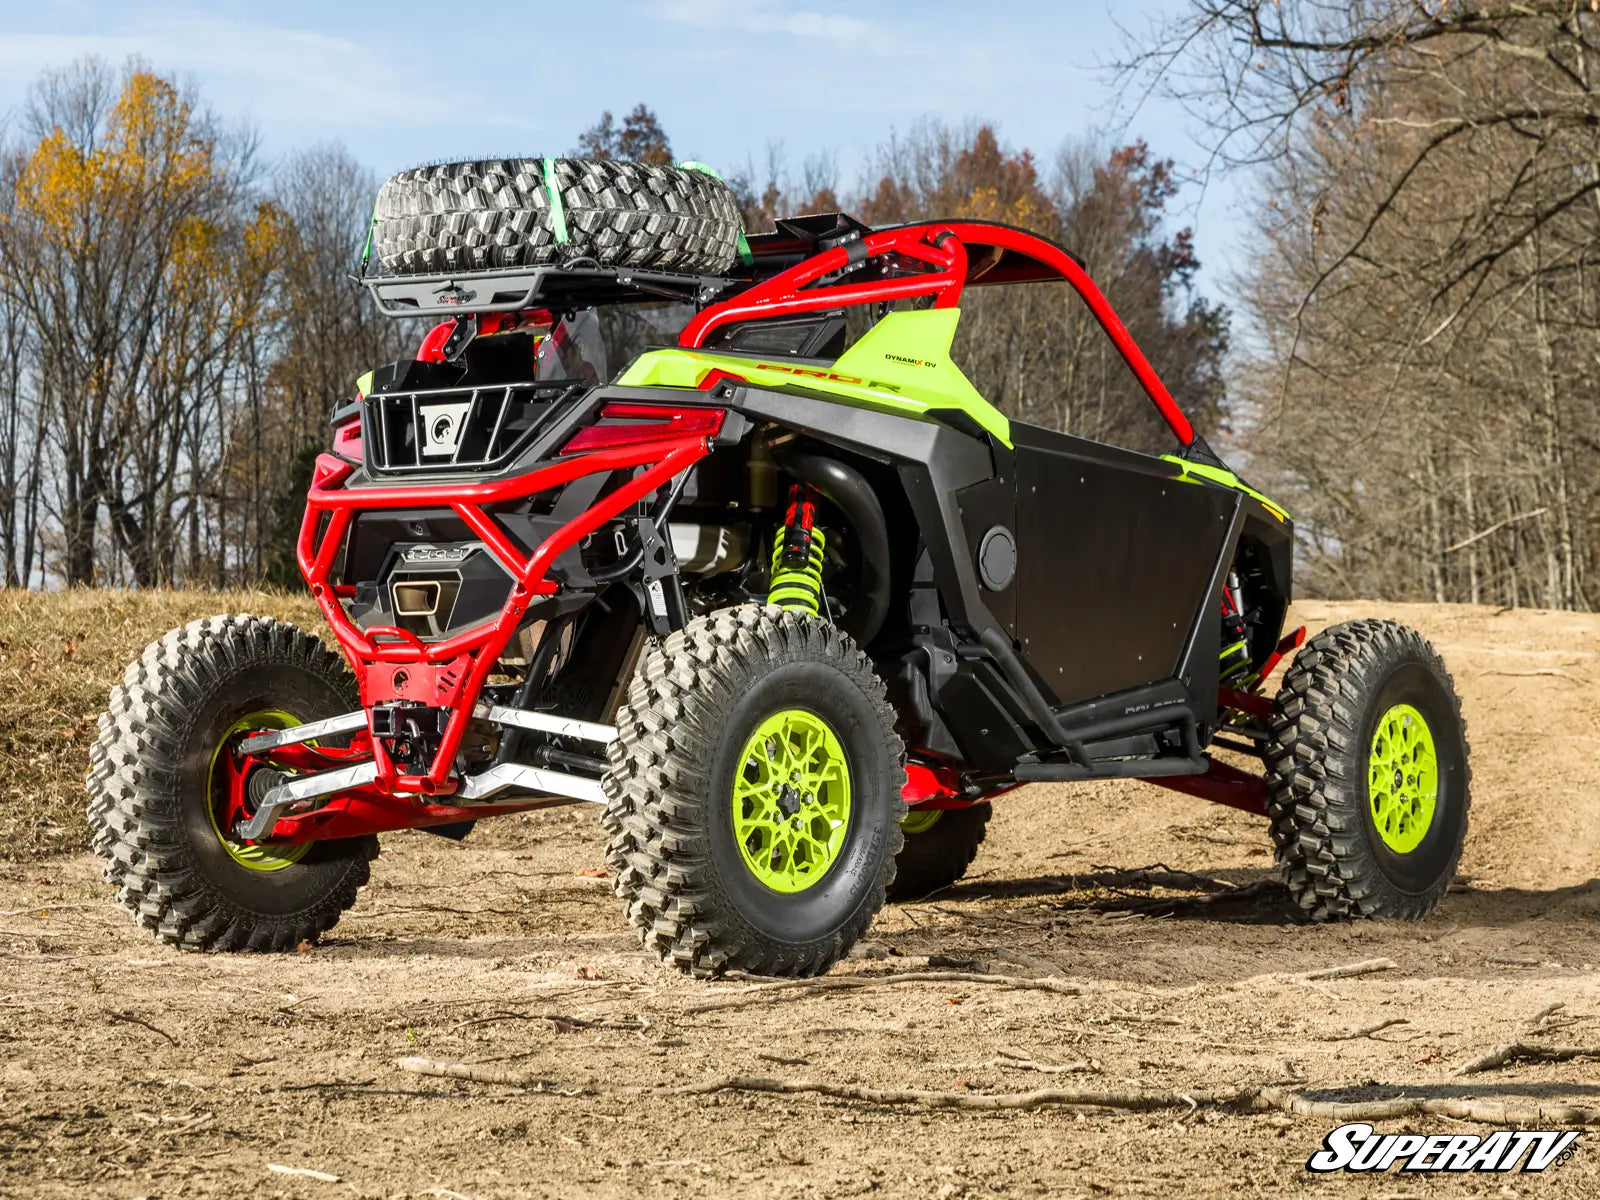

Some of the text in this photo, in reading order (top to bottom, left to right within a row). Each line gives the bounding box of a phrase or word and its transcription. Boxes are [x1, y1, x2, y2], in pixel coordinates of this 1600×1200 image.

[885, 354, 923, 366] DYNAMIX
[757, 364, 901, 393] PRO R
